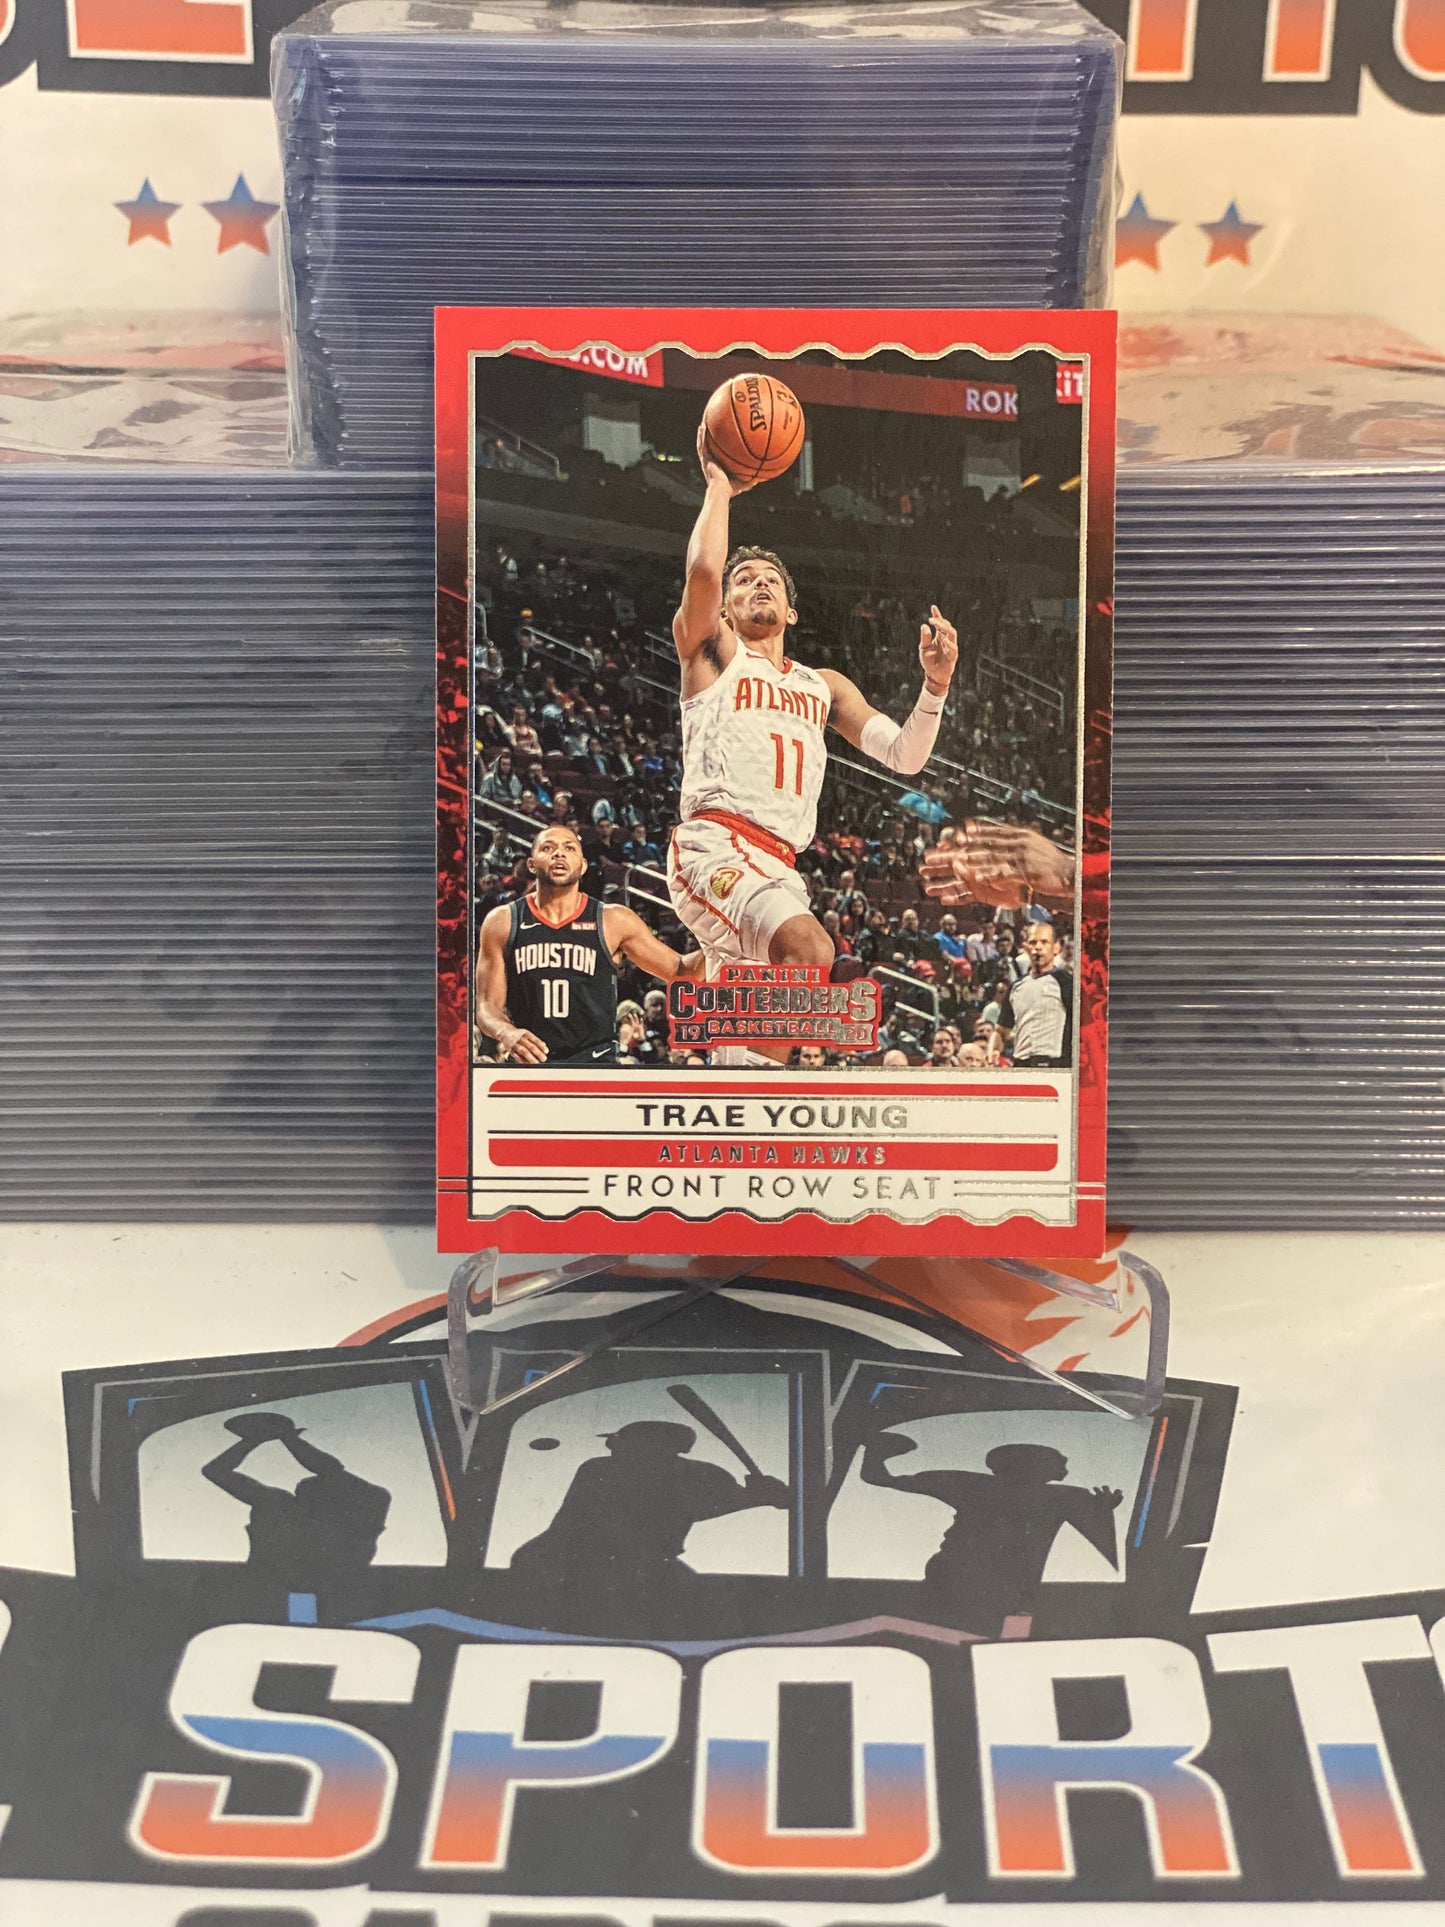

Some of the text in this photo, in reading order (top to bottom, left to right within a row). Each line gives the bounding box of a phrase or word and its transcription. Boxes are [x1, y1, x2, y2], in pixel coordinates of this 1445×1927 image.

[568, 347, 648, 378] .COM
[966, 388, 1018, 415] ROK
[770, 732, 804, 797] 11
[515, 942, 597, 976] HOUSTON
[726, 968, 821, 982] PANINI
[541, 978, 570, 1019] 10
[669, 980, 877, 1021] CONTENDERS
[681, 1020, 868, 1041] 19 BASKETBALL 20
[636, 1103, 909, 1129] TRAE YOUNG
[658, 1145, 887, 1165] ATLANTA HAWKS
[604, 1174, 941, 1199] FRONT ROW SEAT
[129, 1613, 1445, 1880] SPORT
